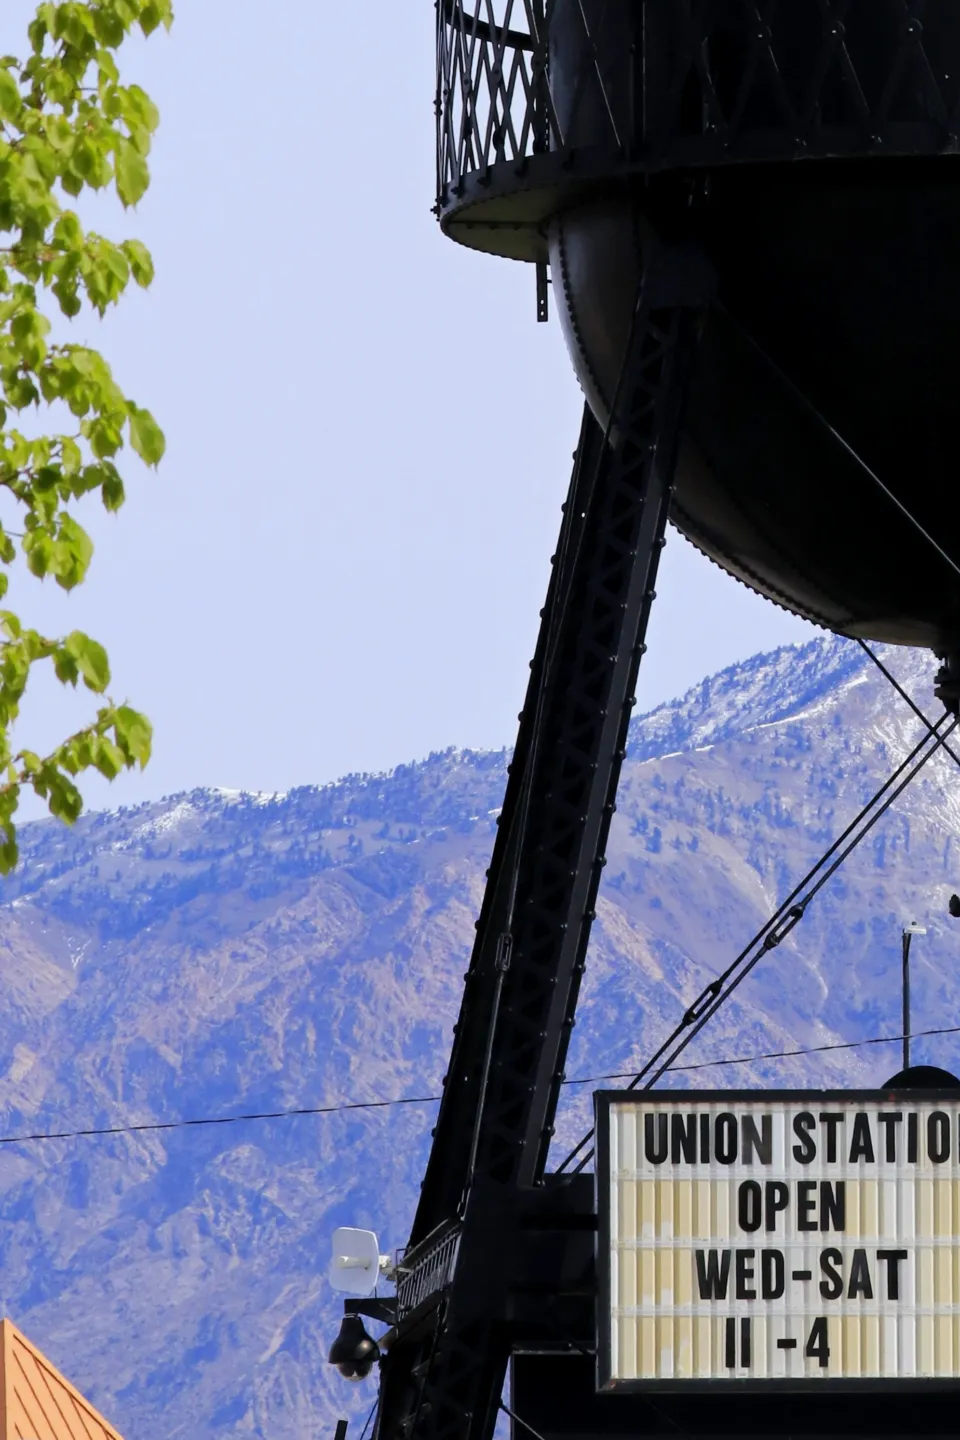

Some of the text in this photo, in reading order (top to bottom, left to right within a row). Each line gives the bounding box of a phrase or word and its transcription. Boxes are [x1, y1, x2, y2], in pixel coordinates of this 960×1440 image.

[644, 1112, 773, 1165] UNION
[738, 1180, 845, 1232] OPEN
[695, 1247, 908, 1301] WED-SAT
